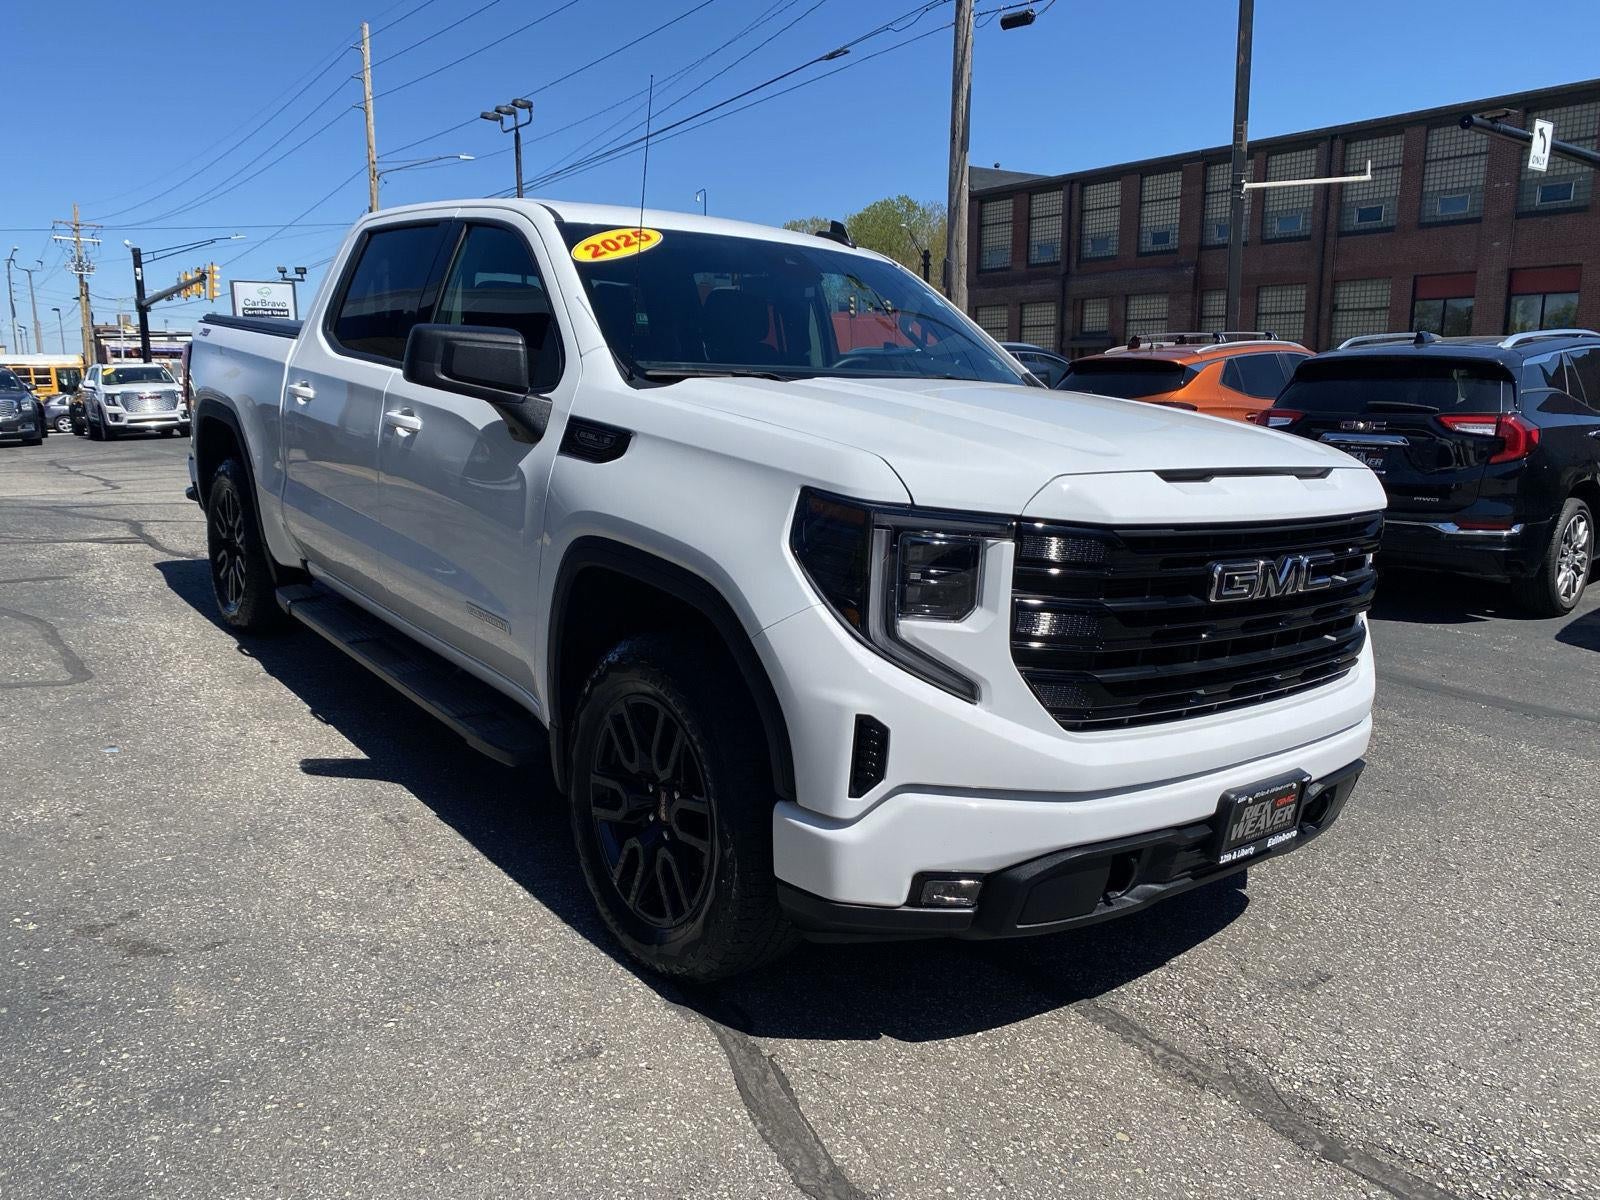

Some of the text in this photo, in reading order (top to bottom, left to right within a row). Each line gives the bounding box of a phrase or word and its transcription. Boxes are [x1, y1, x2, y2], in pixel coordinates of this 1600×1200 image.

[1531, 154, 1546, 166] ONLY
[583, 230, 652, 259] 2025
[243, 298, 287, 307] CarBravo
[1341, 420, 1387, 431] GMC
[1209, 552, 1335, 602] GMC
[1241, 799, 1275, 821] RICK
[1230, 803, 1296, 841] WEAVER
